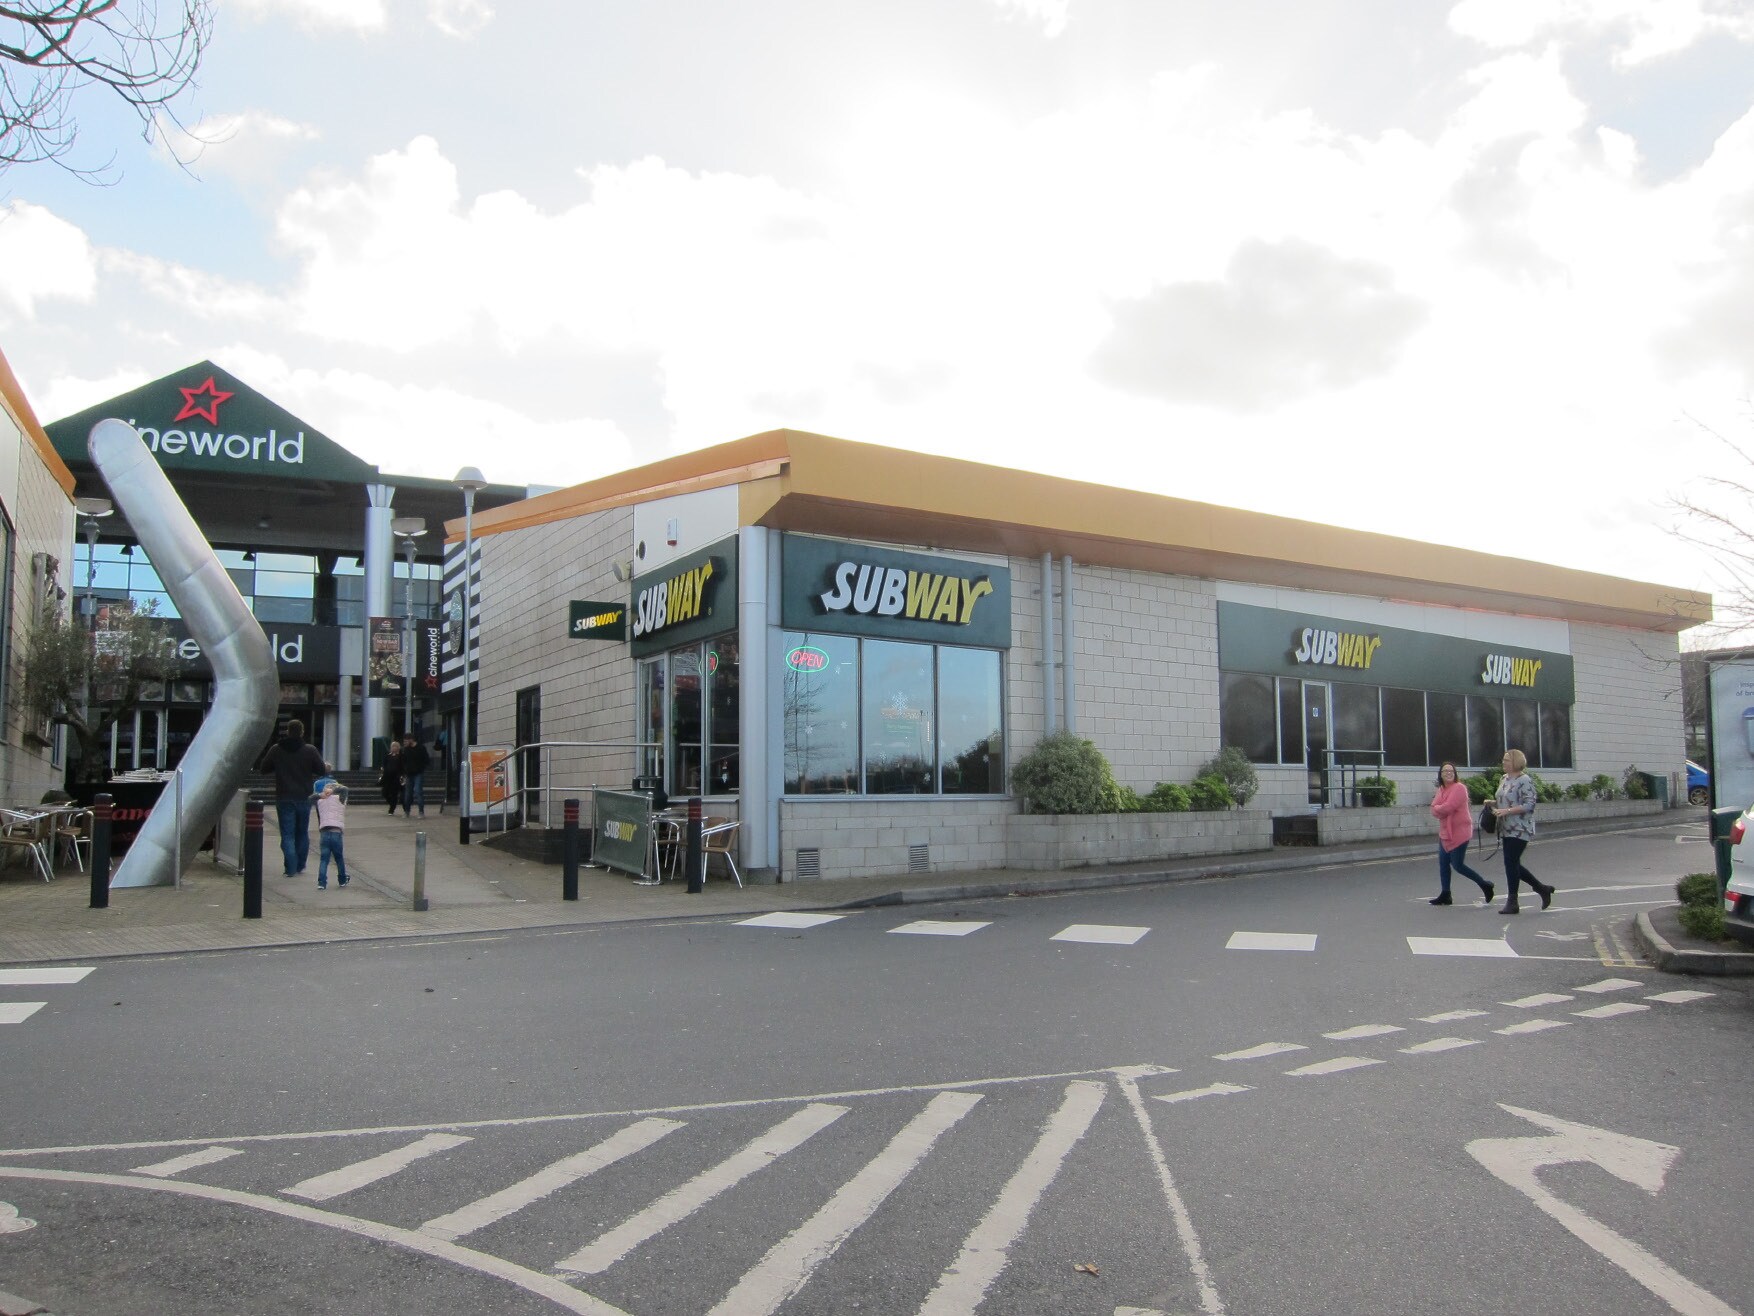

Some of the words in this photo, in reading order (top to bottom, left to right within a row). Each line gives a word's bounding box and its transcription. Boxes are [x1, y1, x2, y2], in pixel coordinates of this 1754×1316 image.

[129, 419, 304, 464] neworld
[633, 559, 714, 638] SUBWAY
[820, 561, 994, 626] SUBWAY
[574, 609, 623, 632] SUBWAY
[427, 627, 438, 677] cineworld
[791, 650, 824, 668] OPEN
[1295, 628, 1383, 669] SUBWAY
[1481, 653, 1542, 688] SUBWAY
[604, 820, 638, 842] SUBWAY
